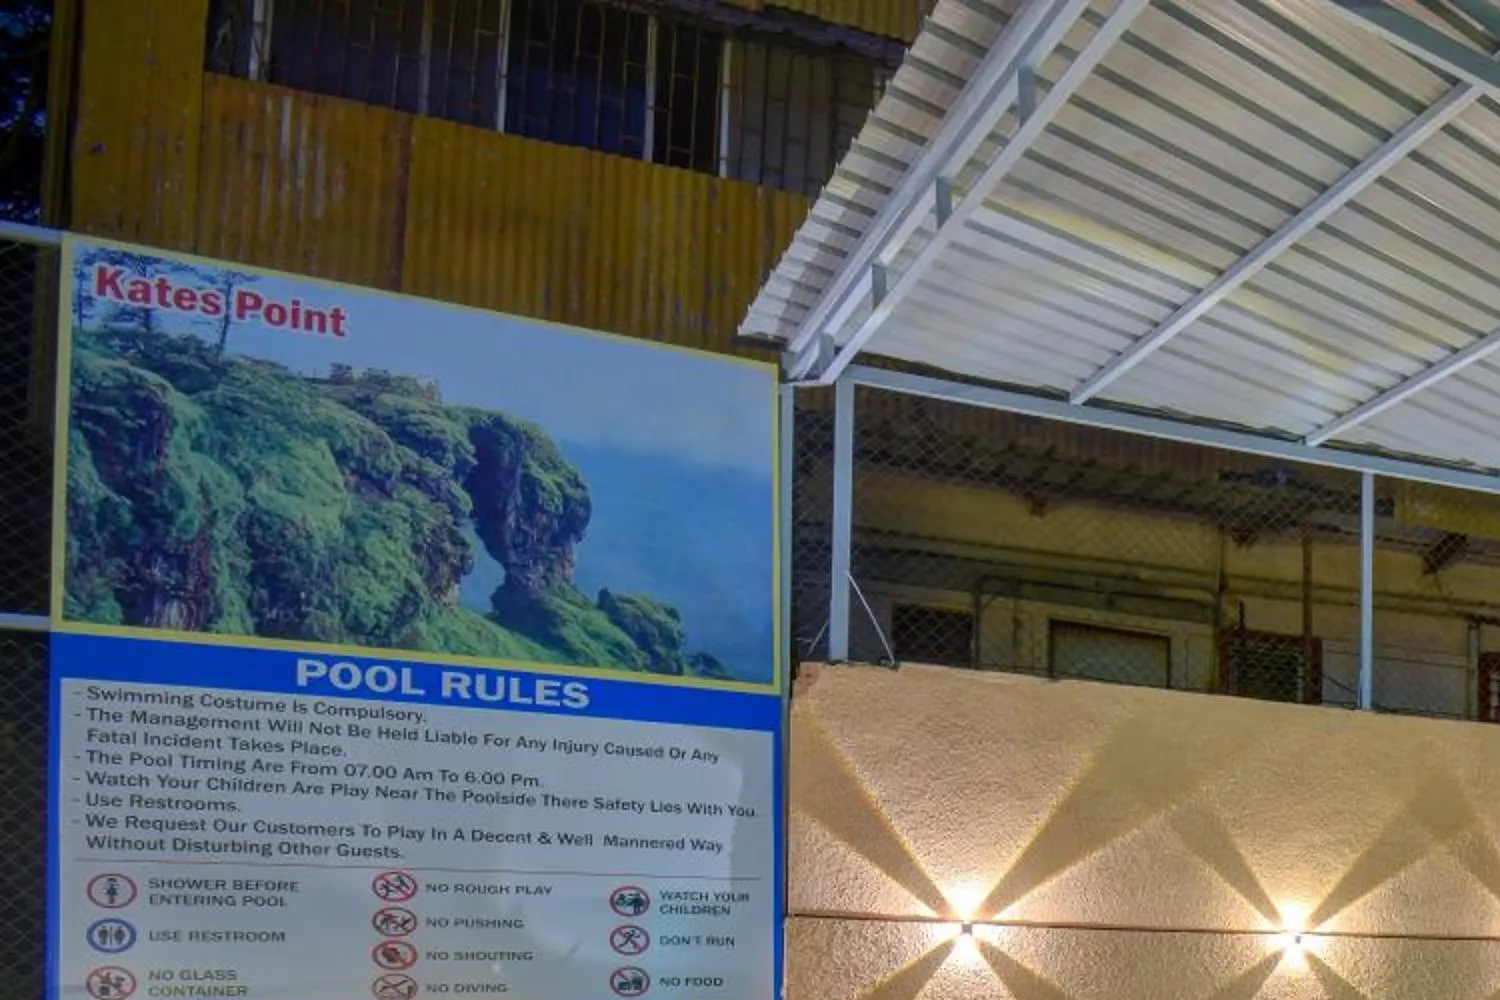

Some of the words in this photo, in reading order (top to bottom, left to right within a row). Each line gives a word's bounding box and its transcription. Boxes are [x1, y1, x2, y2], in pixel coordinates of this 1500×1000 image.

[94, 264, 224, 317] Kates
[235, 290, 346, 337] Point
[296, 658, 425, 696] POOL
[441, 671, 590, 708] RULES
[87, 686, 195, 708] Swimming
[201, 693, 286, 713] Costume
[293, 701, 308, 715] Is
[314, 701, 427, 724] Compulsory.
[86, 707, 123, 722] The
[131, 709, 260, 731] Management
[268, 719, 302, 733] Will
[309, 722, 341, 736] Not
[348, 724, 371, 739] Be
[378, 726, 419, 741] Held
[425, 729, 478, 745] Liable
[484, 733, 510, 748] For
[516, 736, 547, 752] Any
[553, 738, 599, 755] Injury
[604, 742, 664, 758] Caused
[669, 747, 686, 760] Or
[692, 749, 719, 764] Any
[87, 728, 136, 745] Fatal
[144, 731, 221, 749] Incident
[231, 737, 284, 752] Takes
[292, 740, 347, 757] Place.
[86, 750, 122, 765] The
[130, 752, 172, 767] Pool
[181, 754, 246, 774] Timing
[252, 759, 284, 773] Are
[292, 760, 337, 775] From
[344, 764, 397, 779] 07.00
[403, 768, 433, 780] Am
[440, 769, 458, 783] To
[86, 771, 150, 787] Watch
[156, 774, 200, 789] Your
[207, 777, 286, 793] Children
[292, 781, 324, 795] Are
[331, 784, 369, 800] Play
[375, 785, 417, 799] Near
[424, 787, 456, 802] The
[463, 789, 536, 806] Poolside
[542, 793, 589, 809] There
[593, 797, 645, 815] Safety
[651, 800, 682, 813] Lies
[687, 803, 722, 816] With
[86, 793, 122, 807] Use
[130, 794, 241, 812] Restrooms.
[86, 814, 118, 828] We
[125, 815, 206, 832] Request
[213, 818, 247, 832] Our
[253, 819, 355, 837] Customers
[362, 824, 381, 838] To
[387, 825, 424, 842] Play
[431, 827, 447, 841] In
[453, 828, 465, 841] A
[472, 829, 531, 844] Decent
[537, 831, 552, 845] &
[557, 832, 592, 847] Well
[603, 834, 685, 850] Mannered
[690, 838, 723, 854] Way
[86, 835, 164, 850] Without
[173, 838, 272, 857] Disturbing
[278, 842, 330, 856] Other
[148, 877, 227, 891] SHOWER
[232, 879, 301, 893] BEFORE
[425, 883, 449, 893] NO
[453, 883, 510, 895] ROUGH
[515, 885, 552, 895] PLAY
[149, 894, 236, 907] ENTERING
[242, 896, 288, 908] POOL
[660, 891, 709, 901] WATCH
[714, 892, 749, 902] YOUR
[659, 904, 730, 916] CHILDREN
[425, 918, 449, 928] NO
[454, 918, 525, 929] PUSHING
[149, 930, 181, 943] USE
[189, 931, 286, 943] RESTROOM
[706, 935, 735, 947] RUN
[425, 951, 449, 961] NO
[148, 969, 174, 981] NO
[179, 969, 237, 981] GLASS
[659, 977, 681, 987] NO
[685, 977, 724, 987] FOOD
[148, 985, 247, 998] CONTAINER
[425, 983, 449, 993] NO
[453, 983, 509, 993] DIVING
